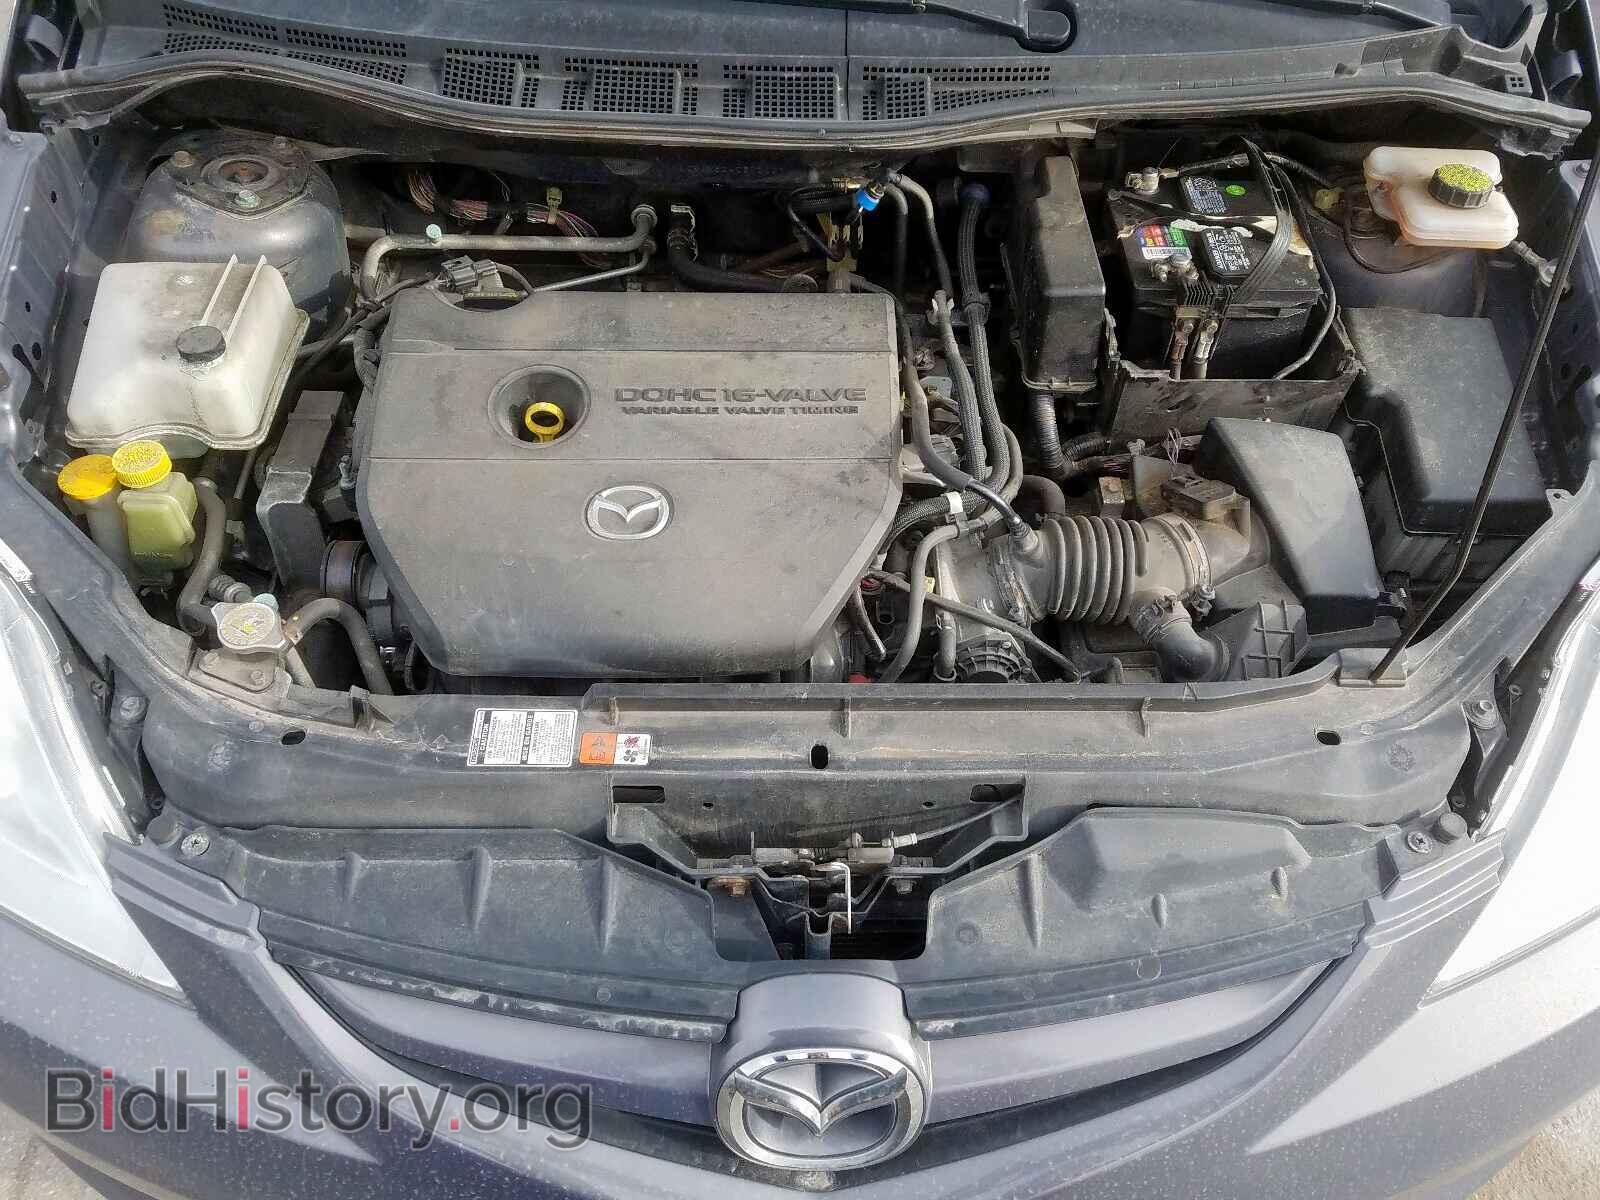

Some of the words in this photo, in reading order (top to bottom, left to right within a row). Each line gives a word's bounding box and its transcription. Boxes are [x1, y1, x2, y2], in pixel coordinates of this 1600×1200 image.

[615, 388, 716, 402] DOHC
[722, 388, 867, 402] 16-VALVE
[621, 405, 720, 415] VARIABLE
[725, 405, 786, 415] VALVE
[789, 405, 859, 415] TIMING
